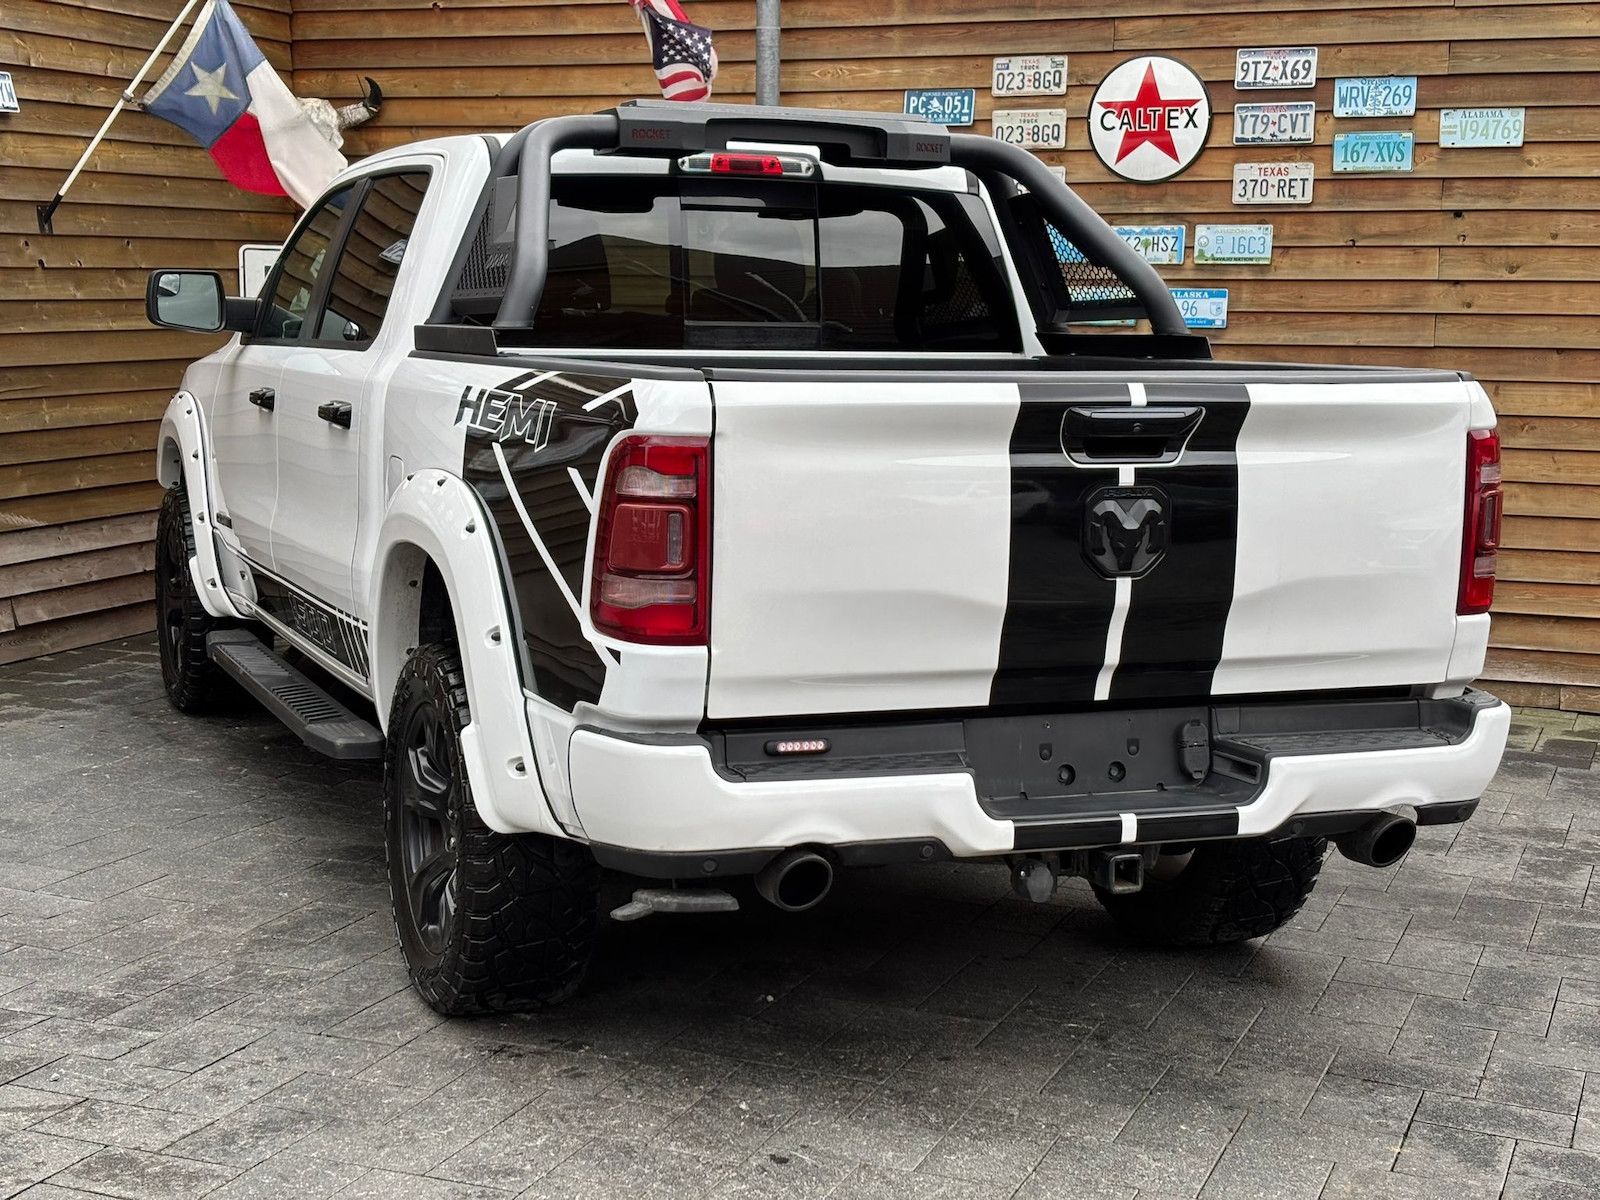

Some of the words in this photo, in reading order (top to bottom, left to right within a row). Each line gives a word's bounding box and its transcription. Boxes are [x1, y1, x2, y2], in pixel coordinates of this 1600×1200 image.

[1240, 60, 1272, 81] 9TZ
[1279, 59, 1312, 80] X69
[996, 72, 1026, 91] 023
[1032, 70, 1063, 90] 8GQ
[1360, 78, 1391, 87] Oregon
[909, 96, 926, 114] PC
[944, 95, 970, 114] 051
[1338, 85, 1371, 108] WRV
[1381, 85, 1412, 107] 269
[1099, 106, 1200, 132] CALTEX
[1238, 113, 1270, 135] Y79
[1277, 112, 1310, 134] CVT
[1460, 109, 1504, 119] ALABAMA
[631, 128, 672, 141] ROCKET
[995, 125, 1024, 144] 023
[1031, 124, 1061, 143] 8GQ
[1459, 118, 1523, 141] V94769
[915, 142, 944, 154] ROCKET
[1257, 166, 1290, 177] TEXAS
[1238, 178, 1269, 199] 370
[1276, 177, 1310, 199] RET
[1151, 236, 1179, 252] HSZ
[1230, 236, 1267, 255] 16C3
[1171, 291, 1209, 299] ALASKA
[453, 385, 557, 453] HEMI
